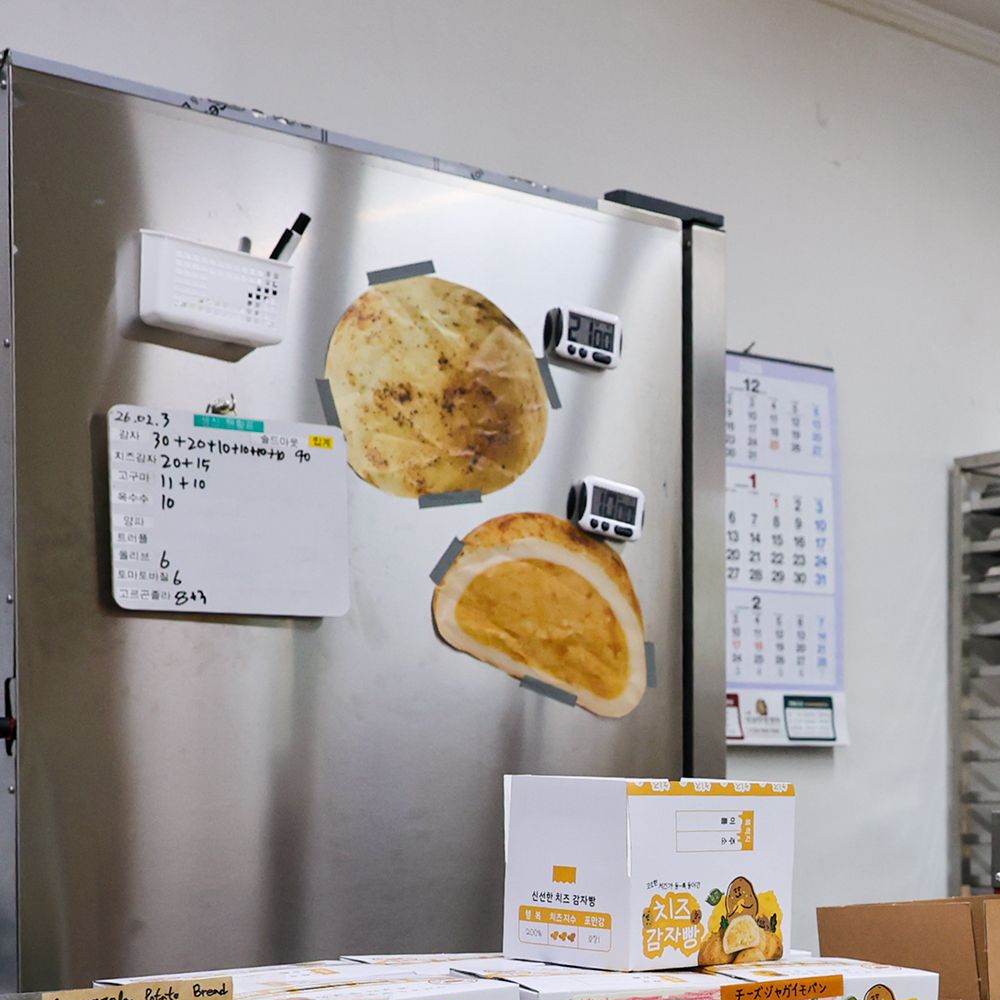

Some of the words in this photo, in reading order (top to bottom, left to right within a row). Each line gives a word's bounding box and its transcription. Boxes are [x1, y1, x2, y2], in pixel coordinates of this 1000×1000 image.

[743, 378, 761, 393] 12
[749, 473, 757, 488] 1
[162, 495, 175, 510] 10
[750, 532, 761, 544] 14
[160, 550, 170, 569] 6
[749, 549, 761, 562] 21
[173, 570, 182, 585] 6
[752, 596, 761, 610] 2
[532, 891, 553, 902] 신선한
[555, 892, 570, 904] 치즈
[573, 895, 596, 907] 감자빵
[653, 898, 691, 922] 치즈
[646, 925, 700, 951] 감자빵
[192, 982, 228, 997] Bread
